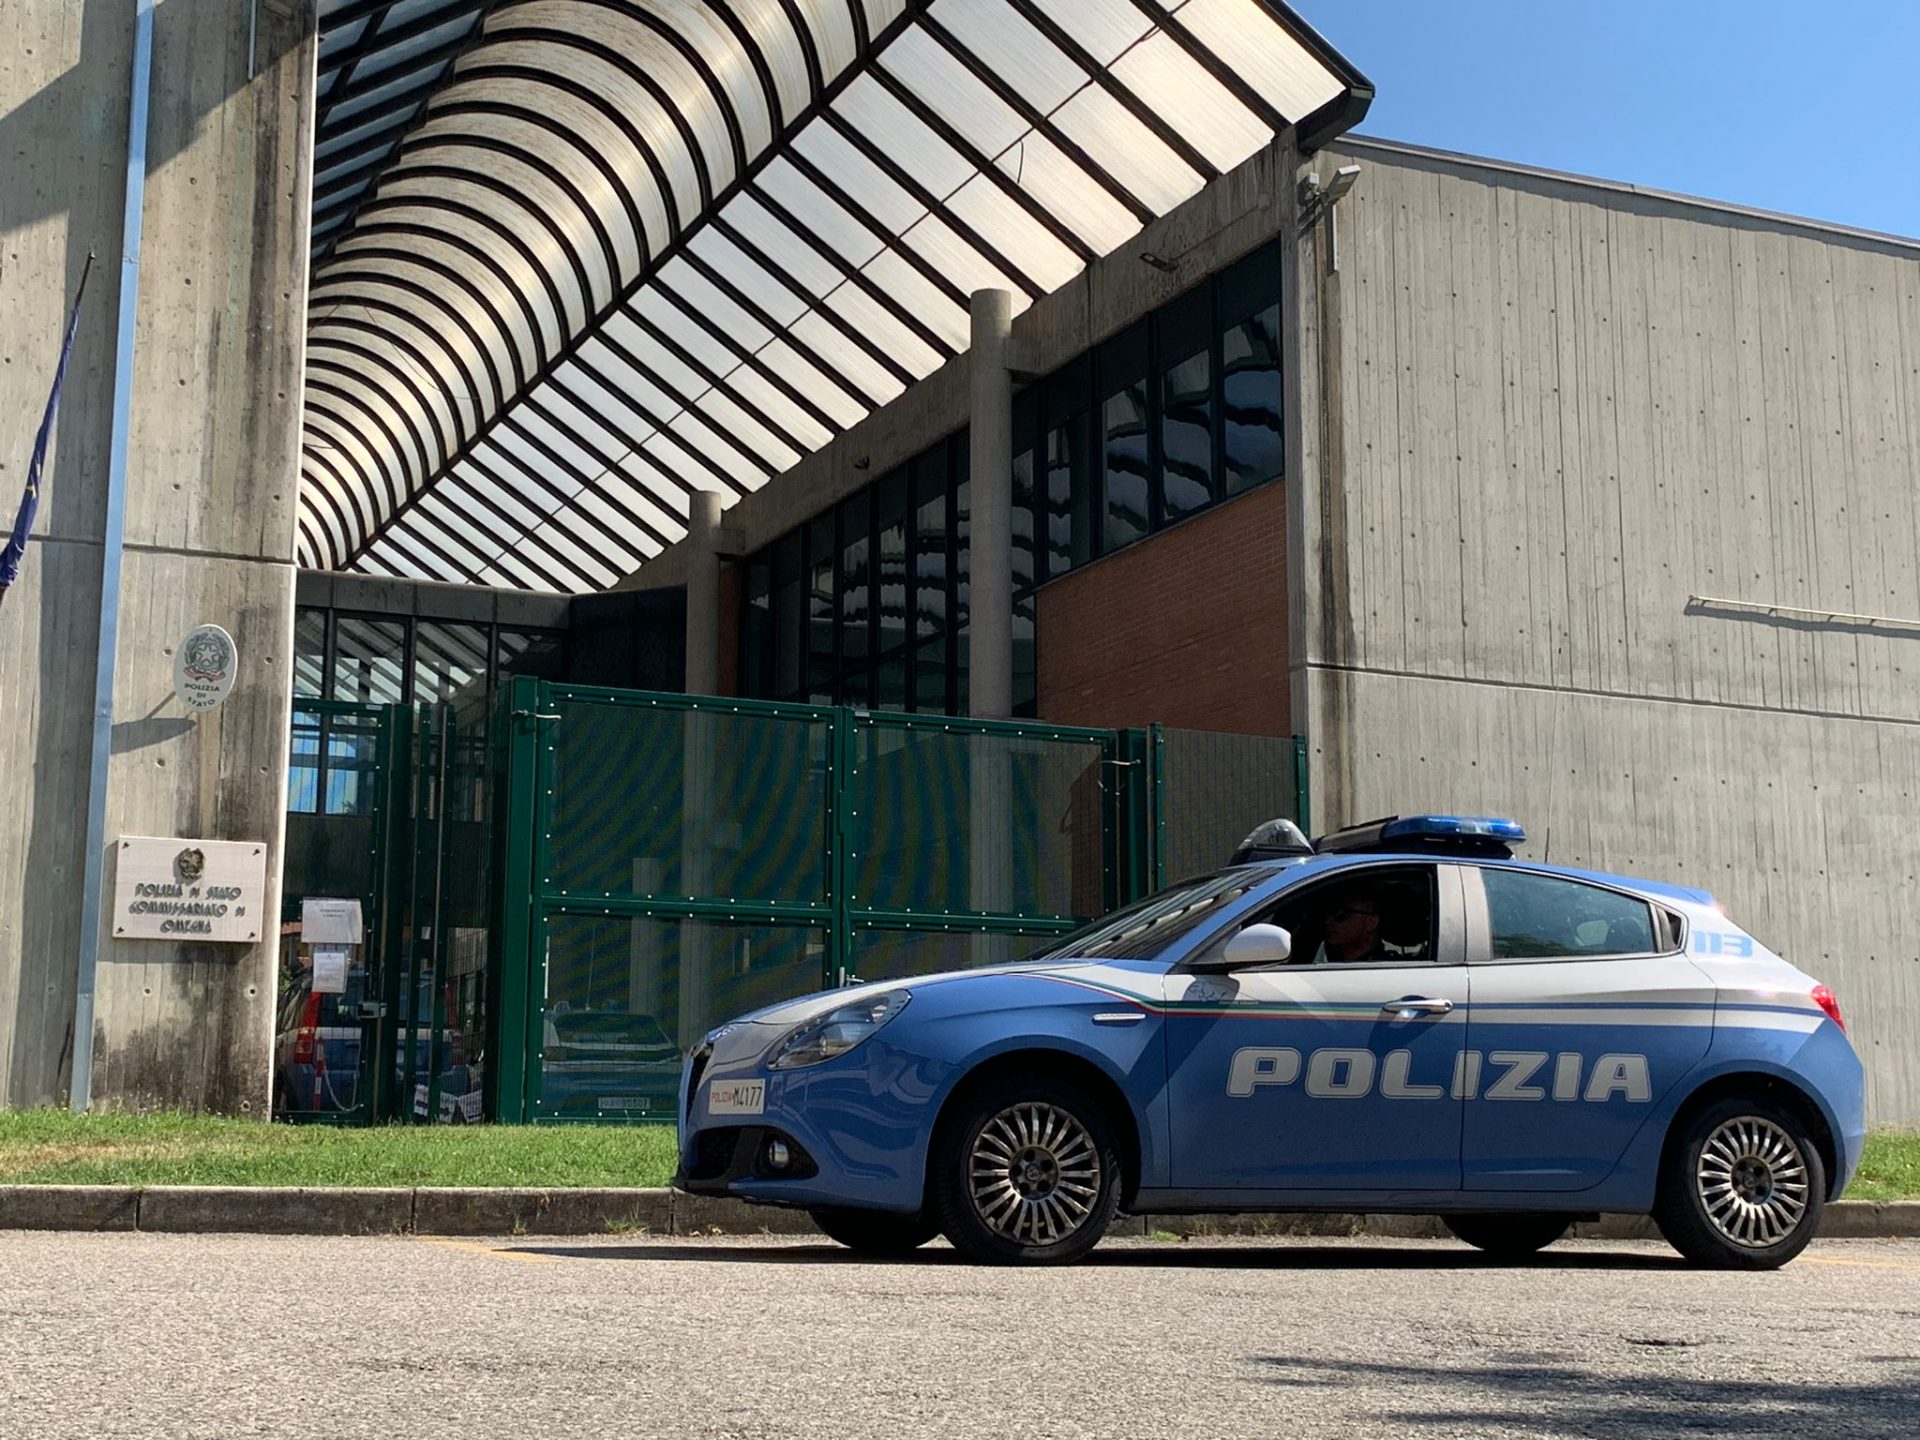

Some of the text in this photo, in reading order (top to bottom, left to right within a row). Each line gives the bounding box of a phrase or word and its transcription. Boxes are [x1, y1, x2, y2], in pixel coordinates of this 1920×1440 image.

[184, 683, 220, 692] POLIZIA
[188, 696, 215, 707] STATO
[134, 883, 183, 898] POLIZIA
[205, 886, 242, 901] STATO
[128, 901, 228, 918] COMMISSARIATO
[160, 919, 212, 934] OMEGNA
[1691, 930, 1753, 958] 113
[1225, 1046, 1653, 1103] POLIZIA
[732, 1086, 762, 1107] M4177
